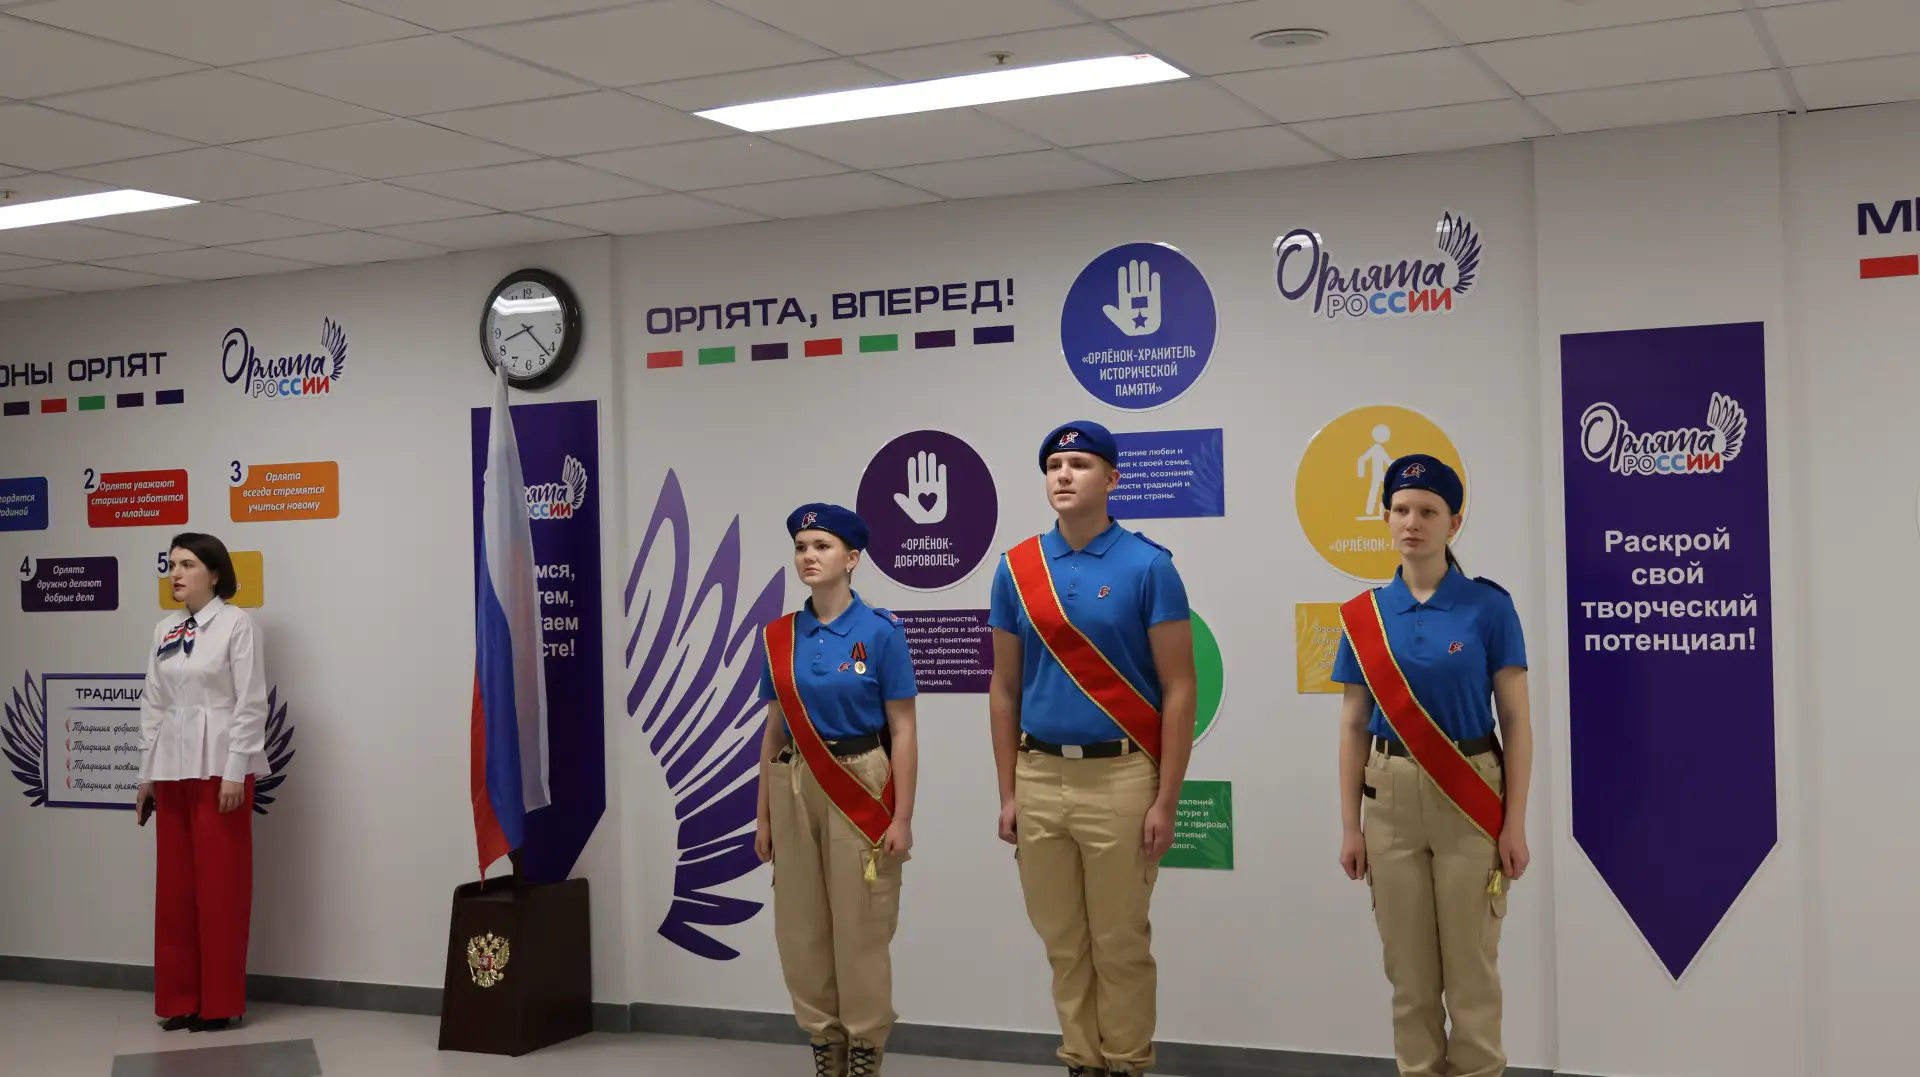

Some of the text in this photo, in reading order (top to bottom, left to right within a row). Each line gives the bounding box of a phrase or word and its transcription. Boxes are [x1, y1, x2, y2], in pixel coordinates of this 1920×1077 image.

[1857, 197, 1920, 235] М
[1277, 228, 1446, 314] Орлята
[645, 278, 1015, 335] ОРЛЯТА, ВПЕРЕД!
[1326, 288, 1452, 318] РОССИИ
[222, 327, 325, 394] Орлята
[1082, 345, 1196, 365] «ОРЛЁНОК-ХРАНИТЕЛЬ
[68, 352, 167, 382] ОРЛЯТ
[1100, 362, 1178, 381] ИСТОРИЧЕСКОЙ
[252, 375, 330, 398] РОССИИ
[1115, 382, 1162, 397] ПАМЯТИ»
[1583, 404, 1716, 470] Орлята
[1148, 448, 1176, 456] любви
[1139, 459, 1163, 467] своей
[1623, 452, 1721, 473] РОССИИ
[84, 468, 95, 489] 2
[230, 460, 242, 483] 3
[265, 472, 301, 484] Орлята
[100, 480, 174, 492] Орлята уважают
[1142, 480, 1183, 489] традиций
[243, 486, 325, 498] всегда стремятся
[1108, 493, 1175, 502] истории страны.
[92, 494, 184, 506] старших и заботятся
[248, 501, 320, 513] учиться новому
[0, 506, 29, 517] одиной
[122, 509, 160, 518] младших
[526, 503, 571, 518] ССИИ
[901, 535, 953, 551] «ОРЛЁНОК-
[1605, 527, 1730, 557] Раскрой
[20, 556, 31, 576] 4
[157, 552, 168, 573] 5
[894, 554, 960, 568] ДОБРОВОЛЕЦ»
[53, 565, 85, 576] Орлята
[1631, 561, 1704, 586] свой
[37, 579, 102, 590] дружно делают
[44, 593, 95, 603] добрые дела
[1581, 593, 1757, 624] творческий
[541, 617, 579, 631] аем
[937, 615, 979, 624] ценностей,
[928, 626, 959, 635] доброта
[1584, 627, 1756, 654] потенциал!
[937, 667, 993, 676] волонтёрского
[72, 721, 110, 734] Традиция
[72, 741, 111, 753] Традиция
[72, 760, 111, 772] Традиция
[73, 778, 112, 791] Традиция
[1191, 821, 1229, 830] природе,
